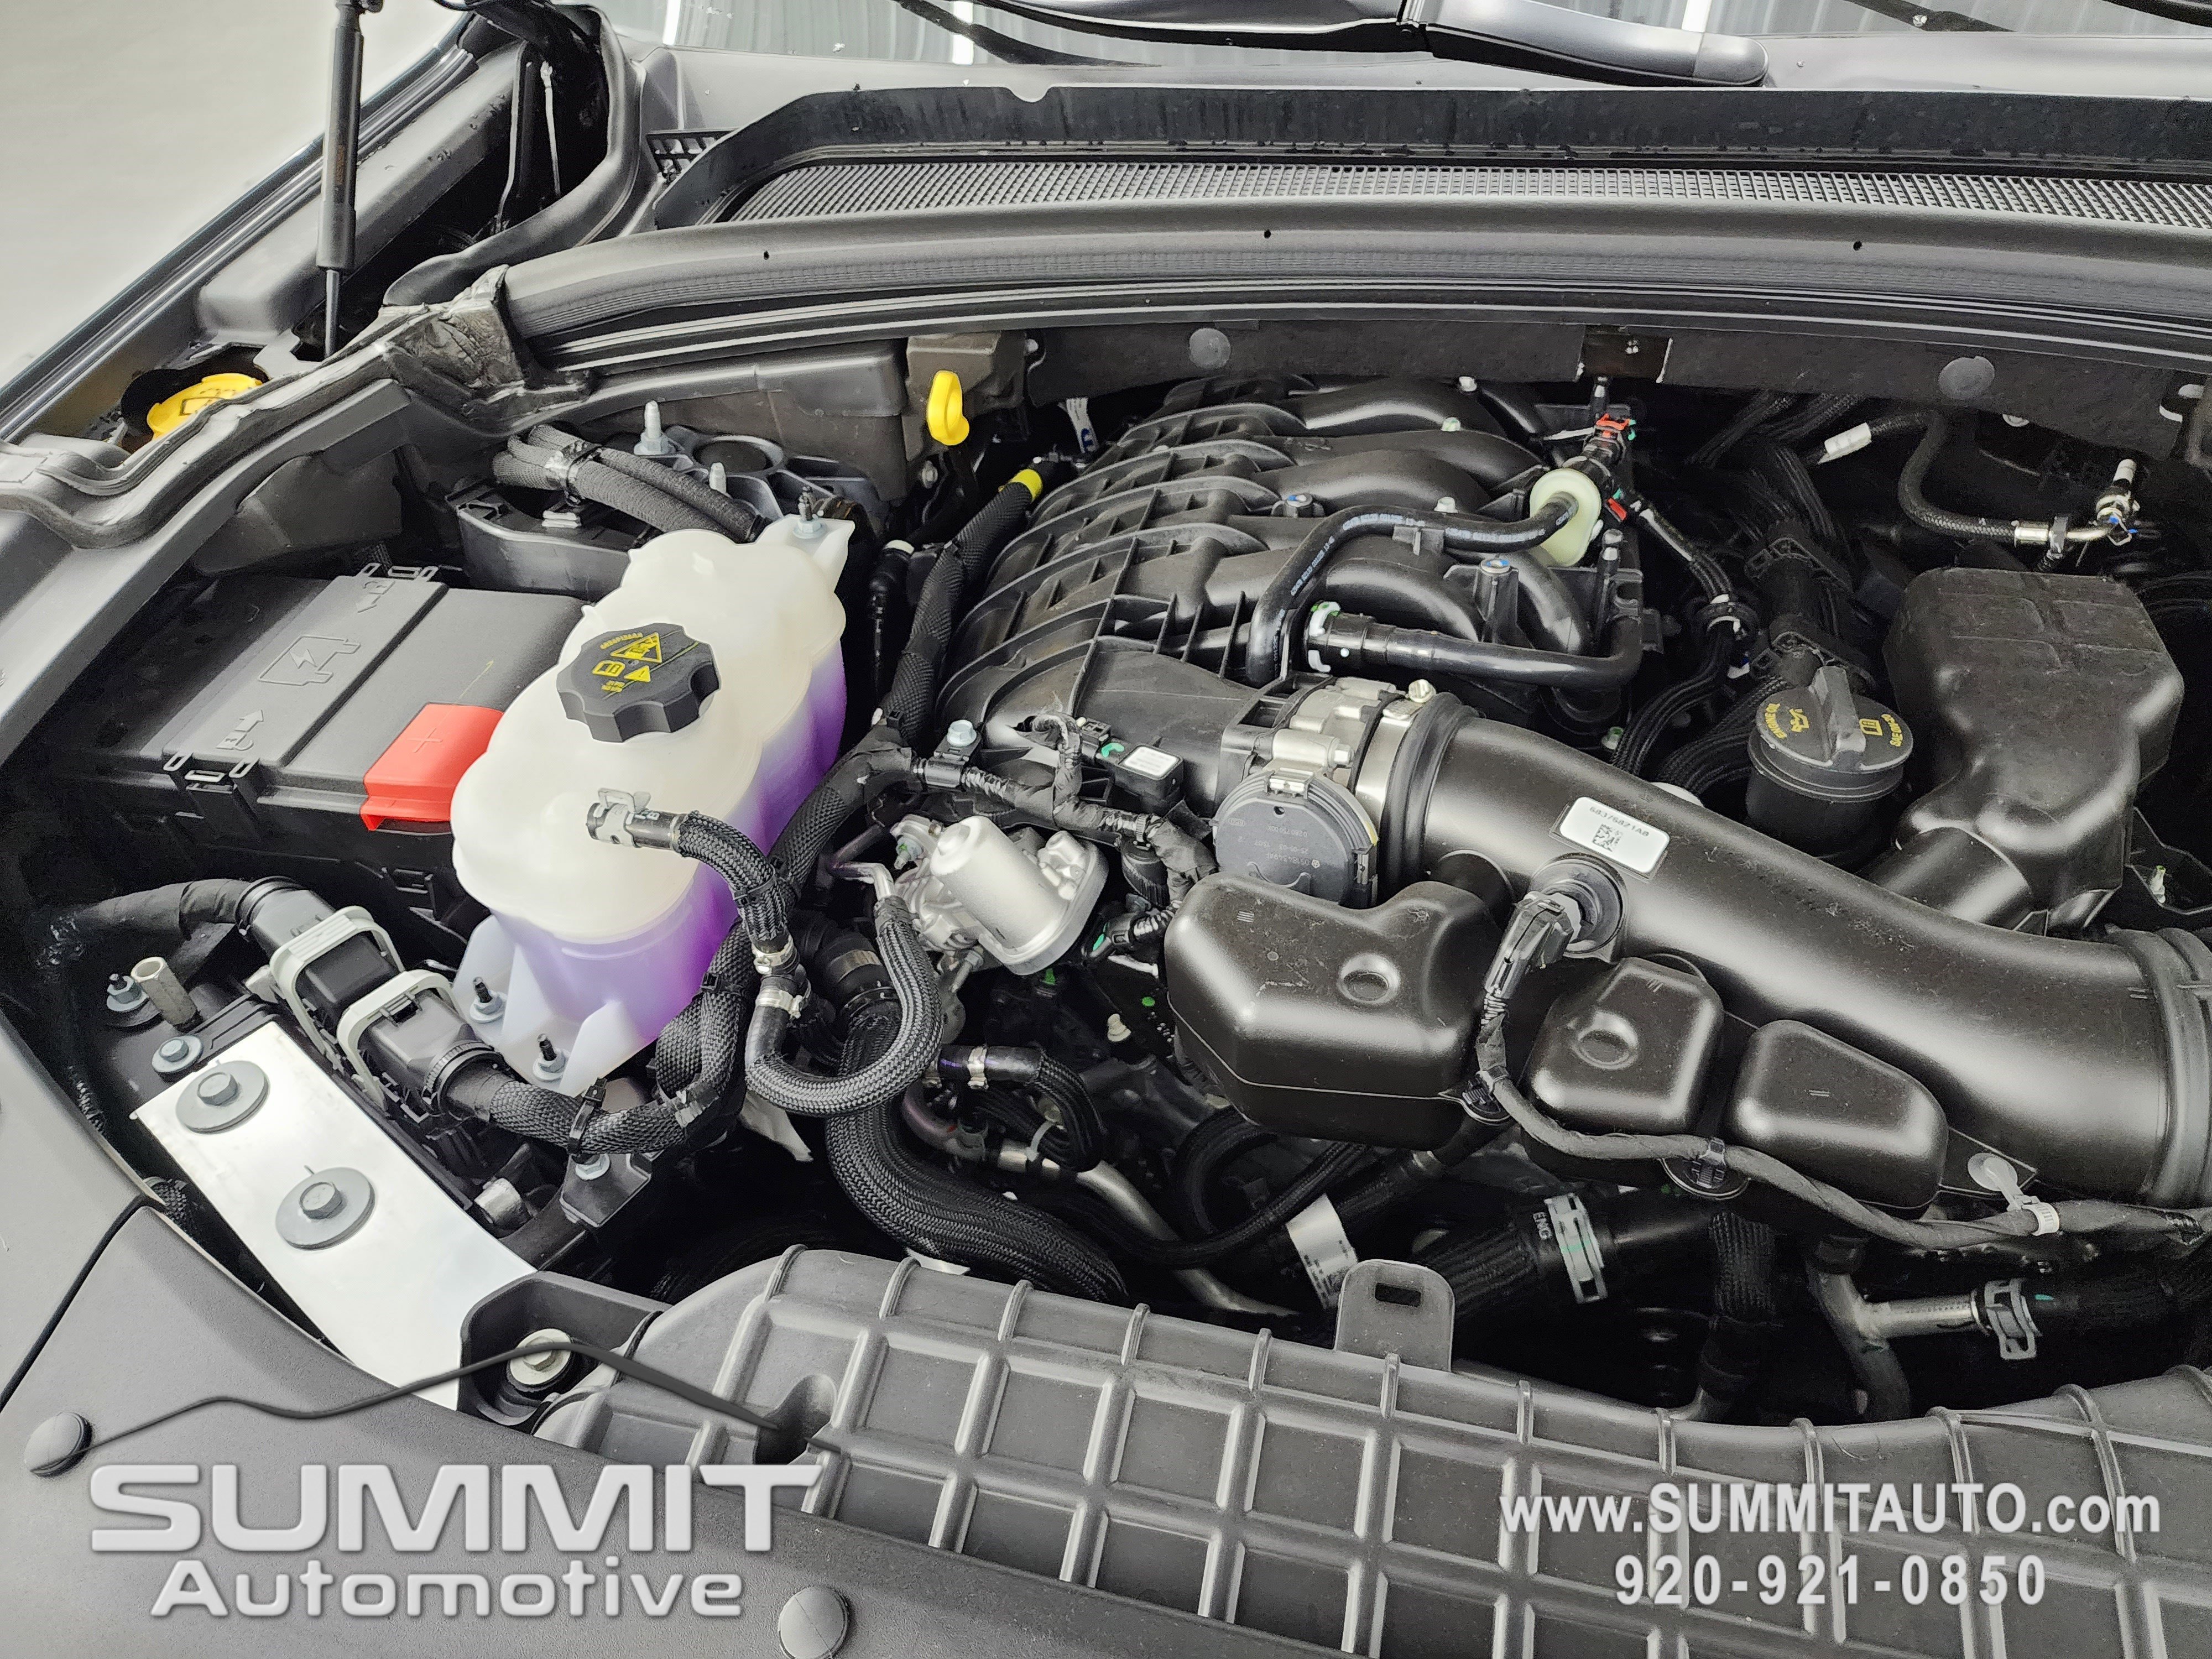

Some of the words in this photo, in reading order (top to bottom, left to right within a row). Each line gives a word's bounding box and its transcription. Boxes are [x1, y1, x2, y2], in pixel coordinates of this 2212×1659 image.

[1766, 703, 1781, 713] OIL
[1765, 712, 1787, 739] ENGINE
[1532, 1211, 1553, 1240] ENG
